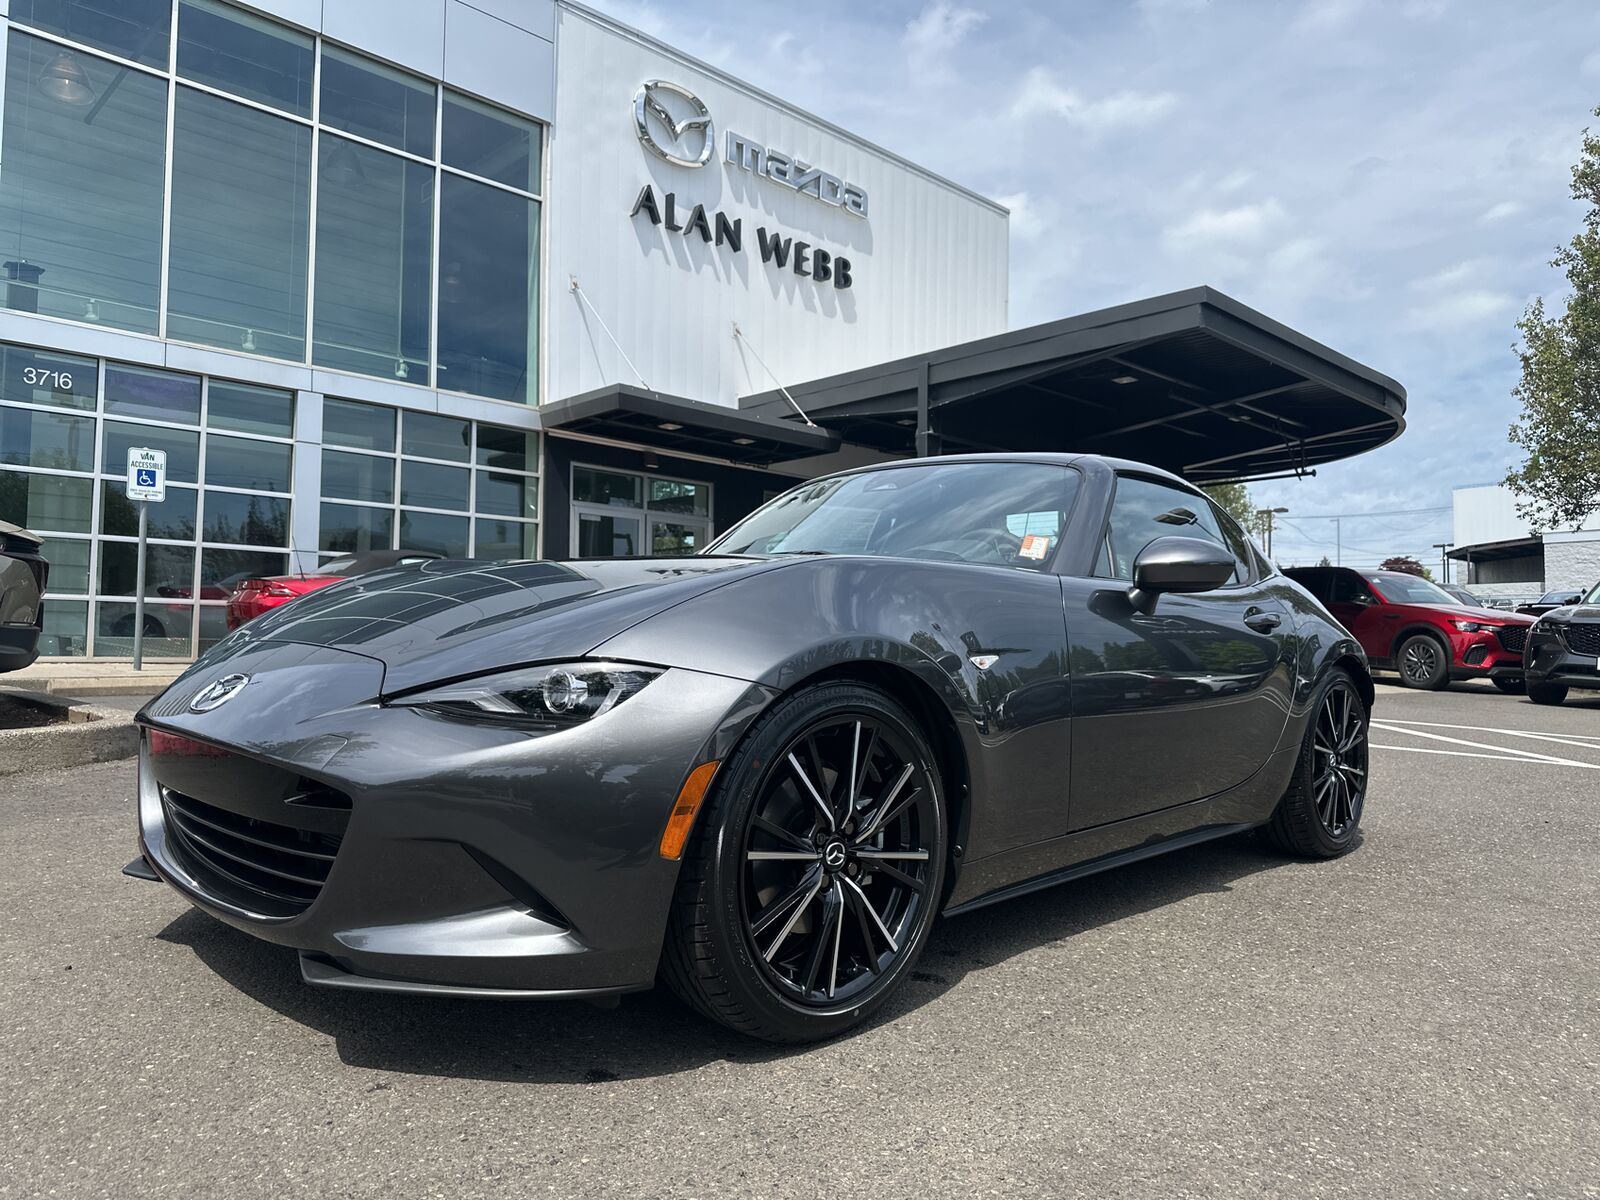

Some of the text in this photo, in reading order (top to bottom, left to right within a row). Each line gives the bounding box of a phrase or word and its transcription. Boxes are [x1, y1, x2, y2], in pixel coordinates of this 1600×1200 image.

[630, 184, 853, 289] ALAN WEBB
[23, 367, 73, 389] 3716
[140, 452, 155, 461] VAN
[130, 460, 164, 471] ACCESSIBLE
